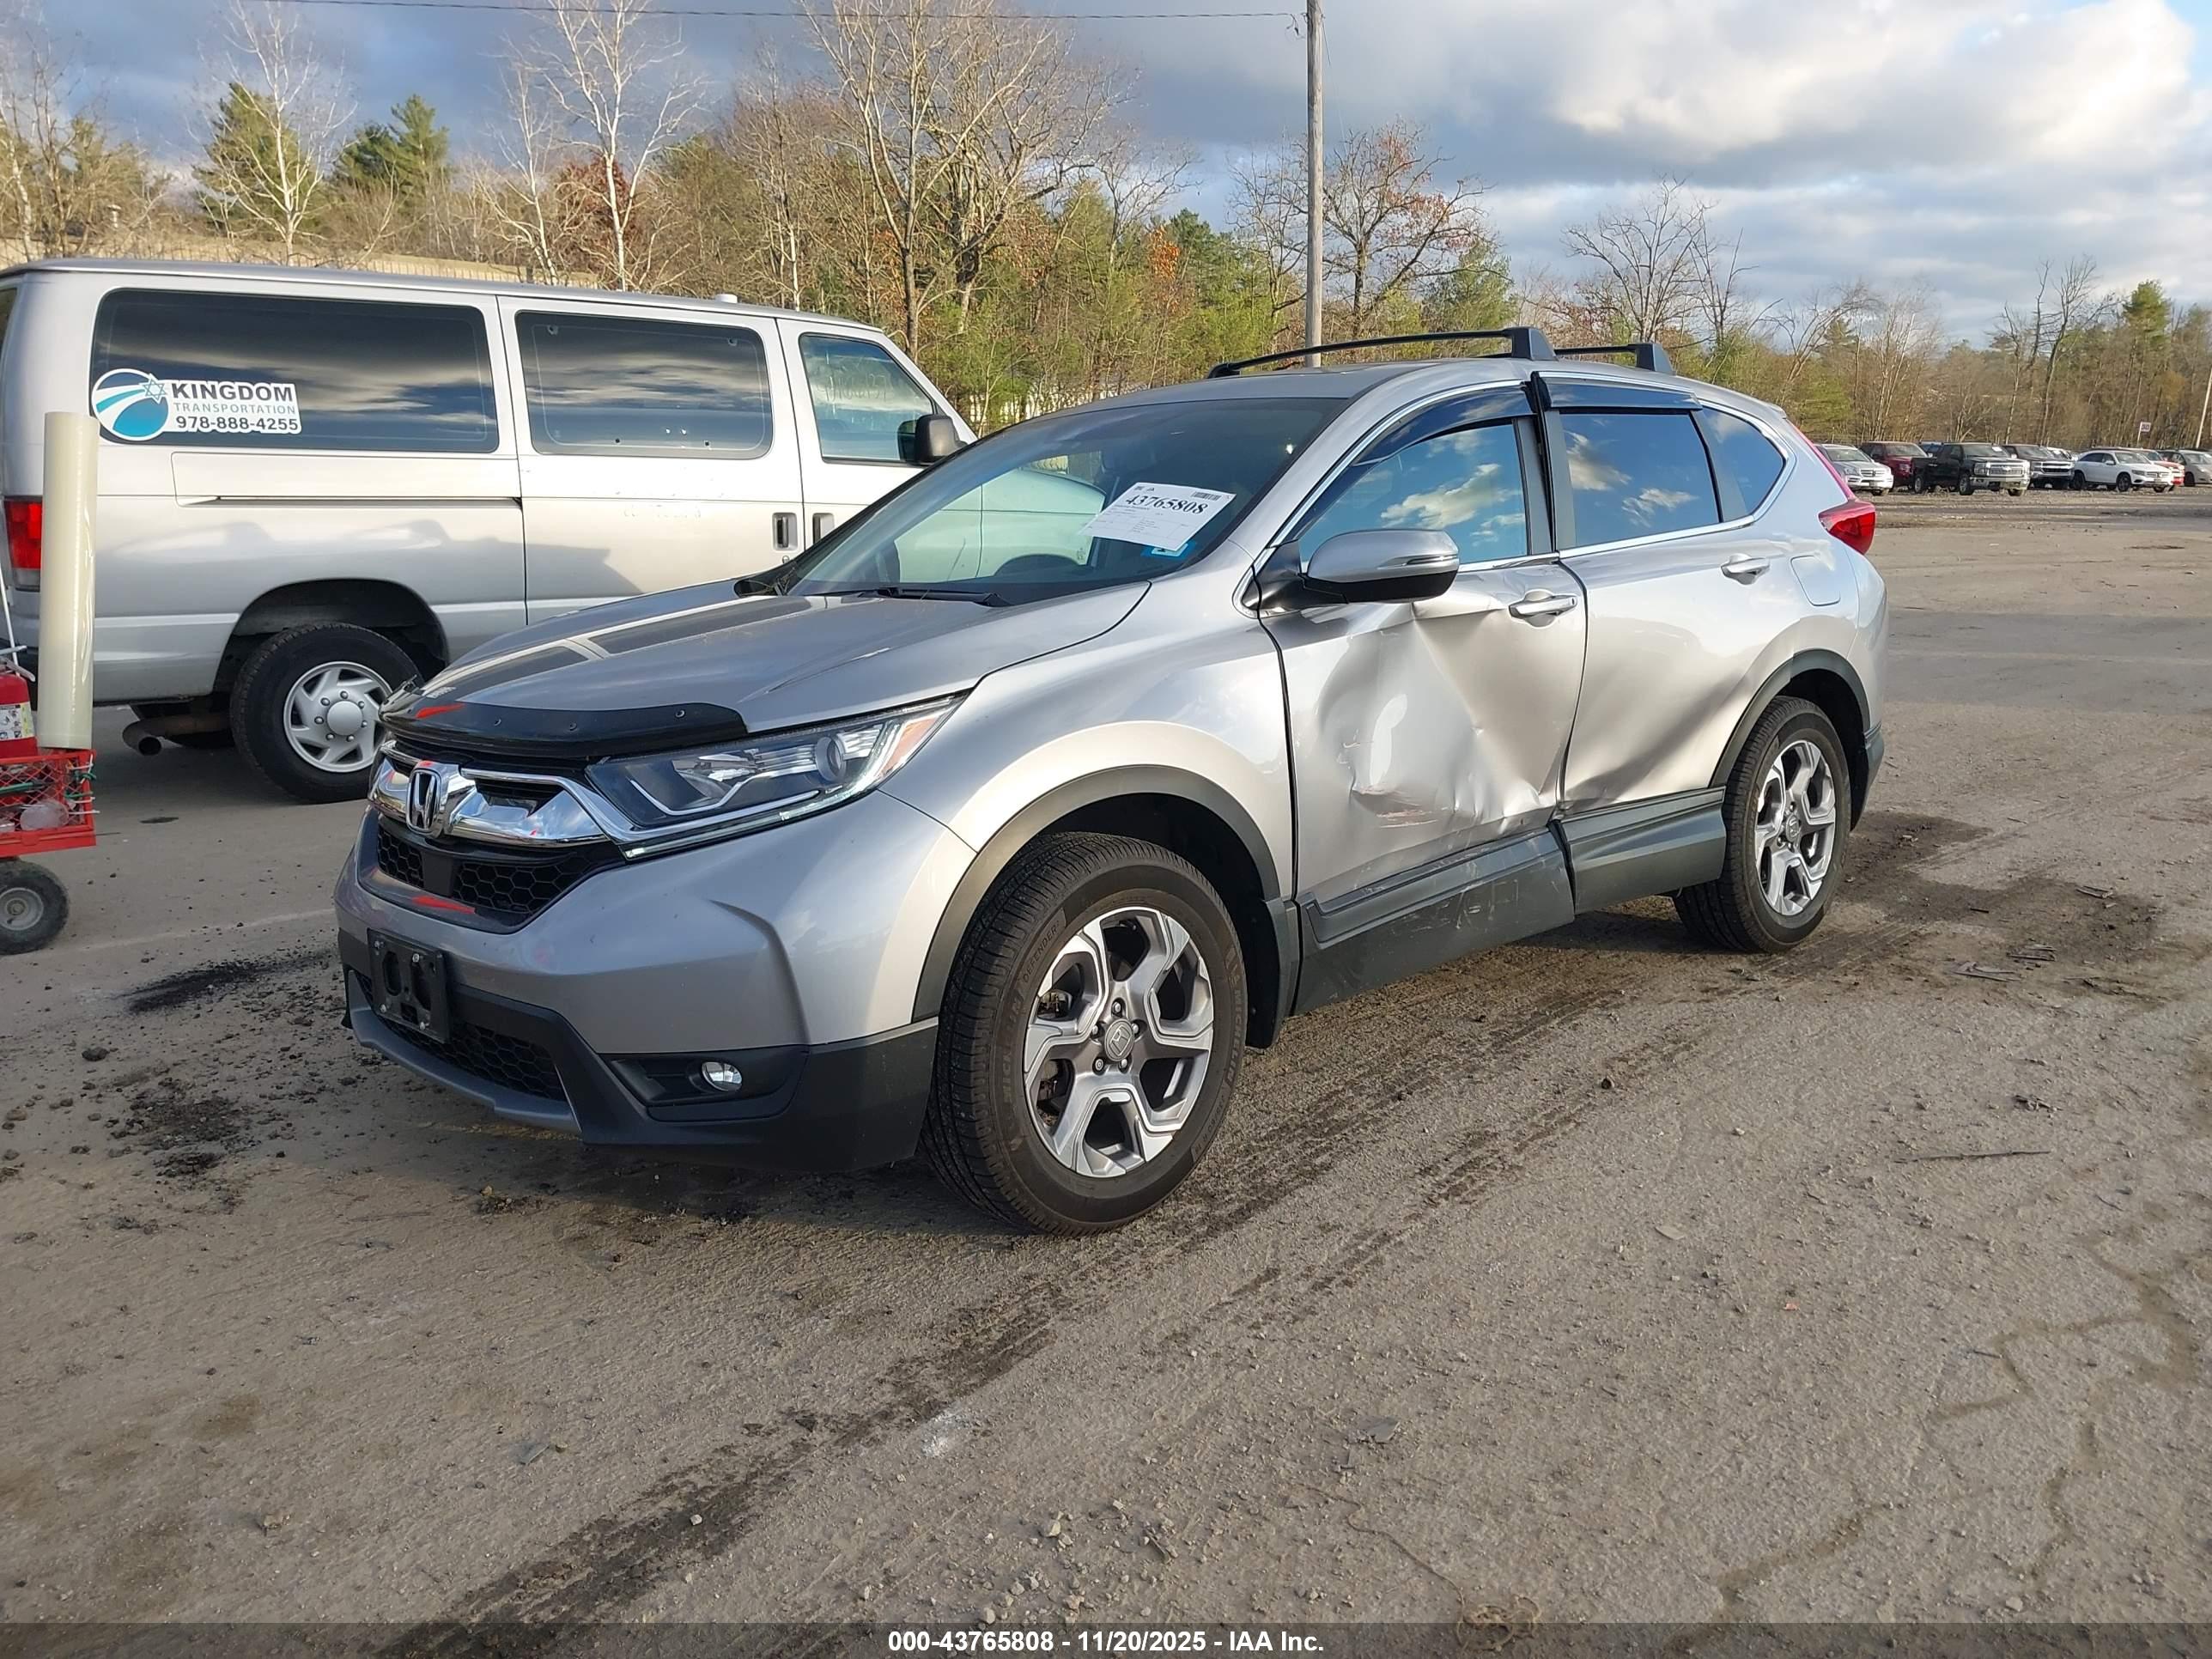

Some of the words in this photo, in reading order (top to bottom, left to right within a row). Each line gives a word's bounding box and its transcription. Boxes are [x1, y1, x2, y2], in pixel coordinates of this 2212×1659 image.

[172, 383, 293, 402] KINGDOM
[174, 402, 295, 415] TRANSPORTATION
[176, 416, 298, 431] 978-888-4255
[1125, 494, 1209, 514] 43765808
[1225, 988, 1244, 1082] MICHELIN
